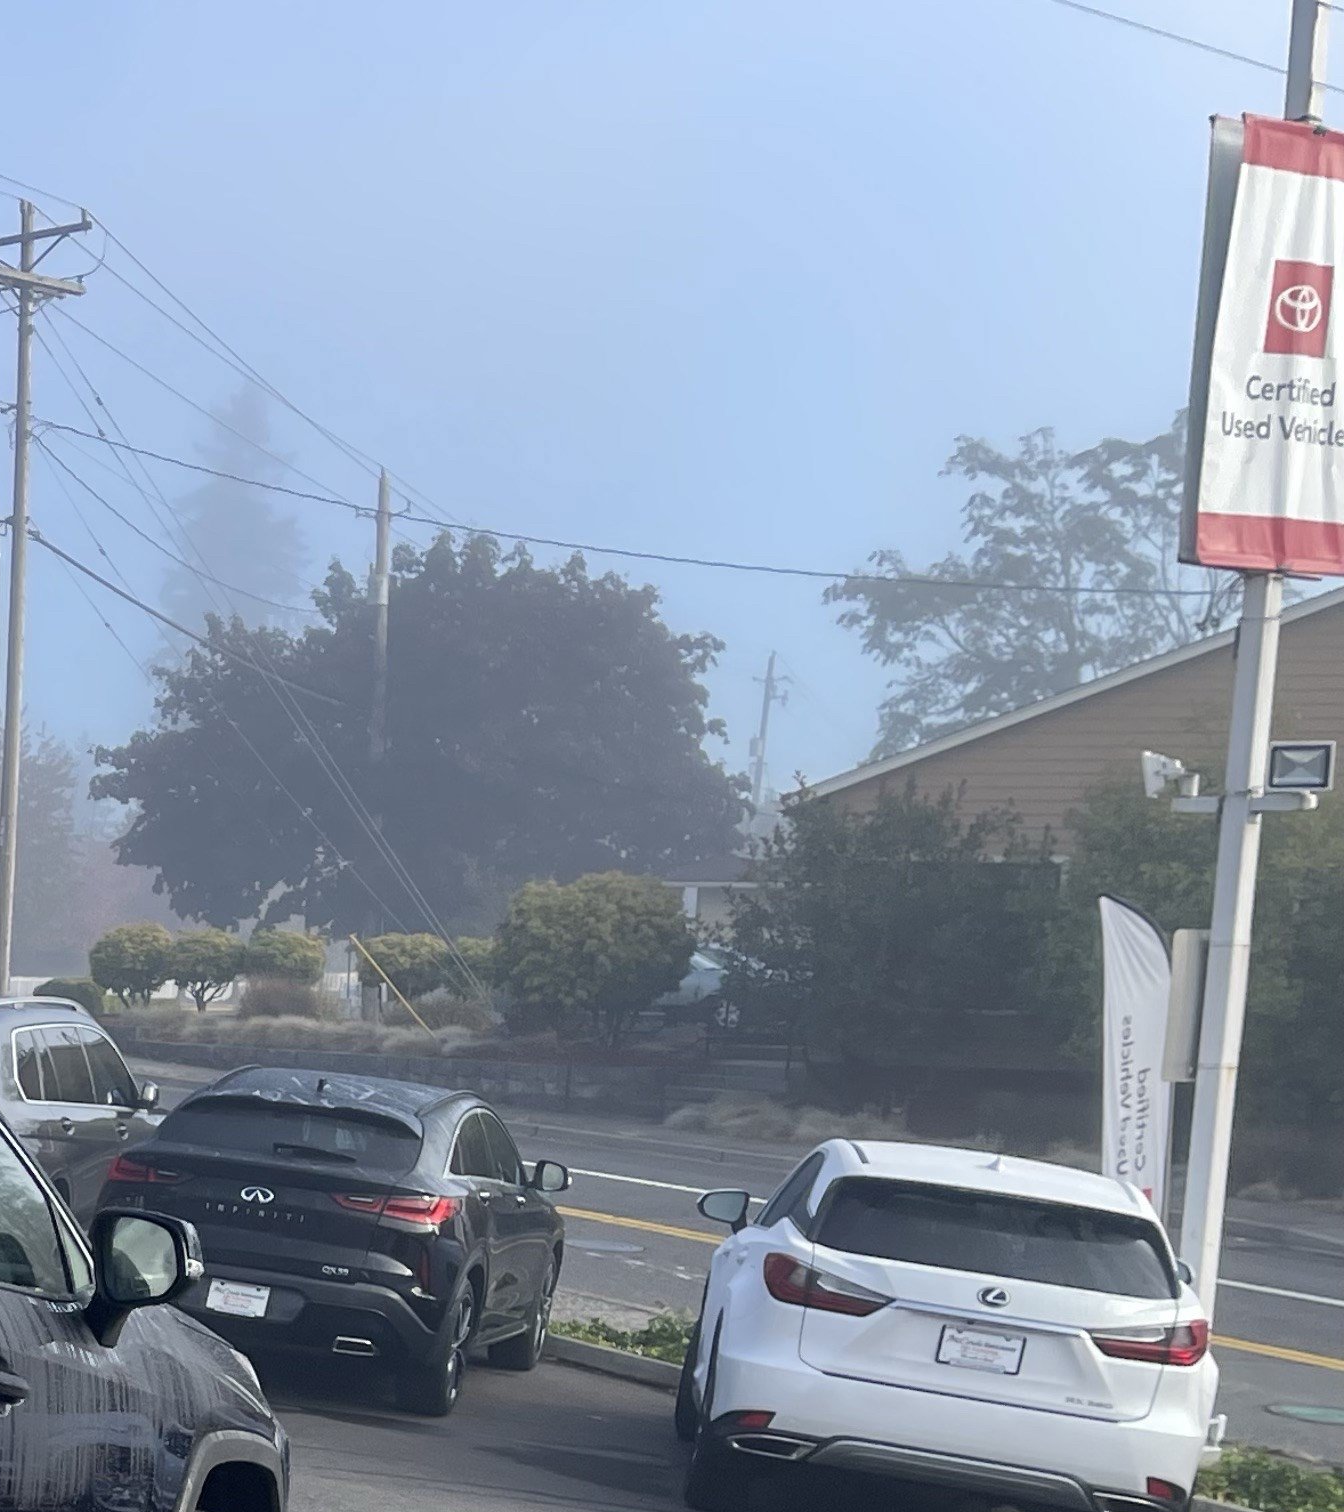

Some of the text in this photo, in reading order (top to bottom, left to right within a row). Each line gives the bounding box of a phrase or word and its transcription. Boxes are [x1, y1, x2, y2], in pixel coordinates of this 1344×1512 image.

[1245, 374, 1336, 407] Certified
[1221, 411, 1344, 447] Used Vehicle
